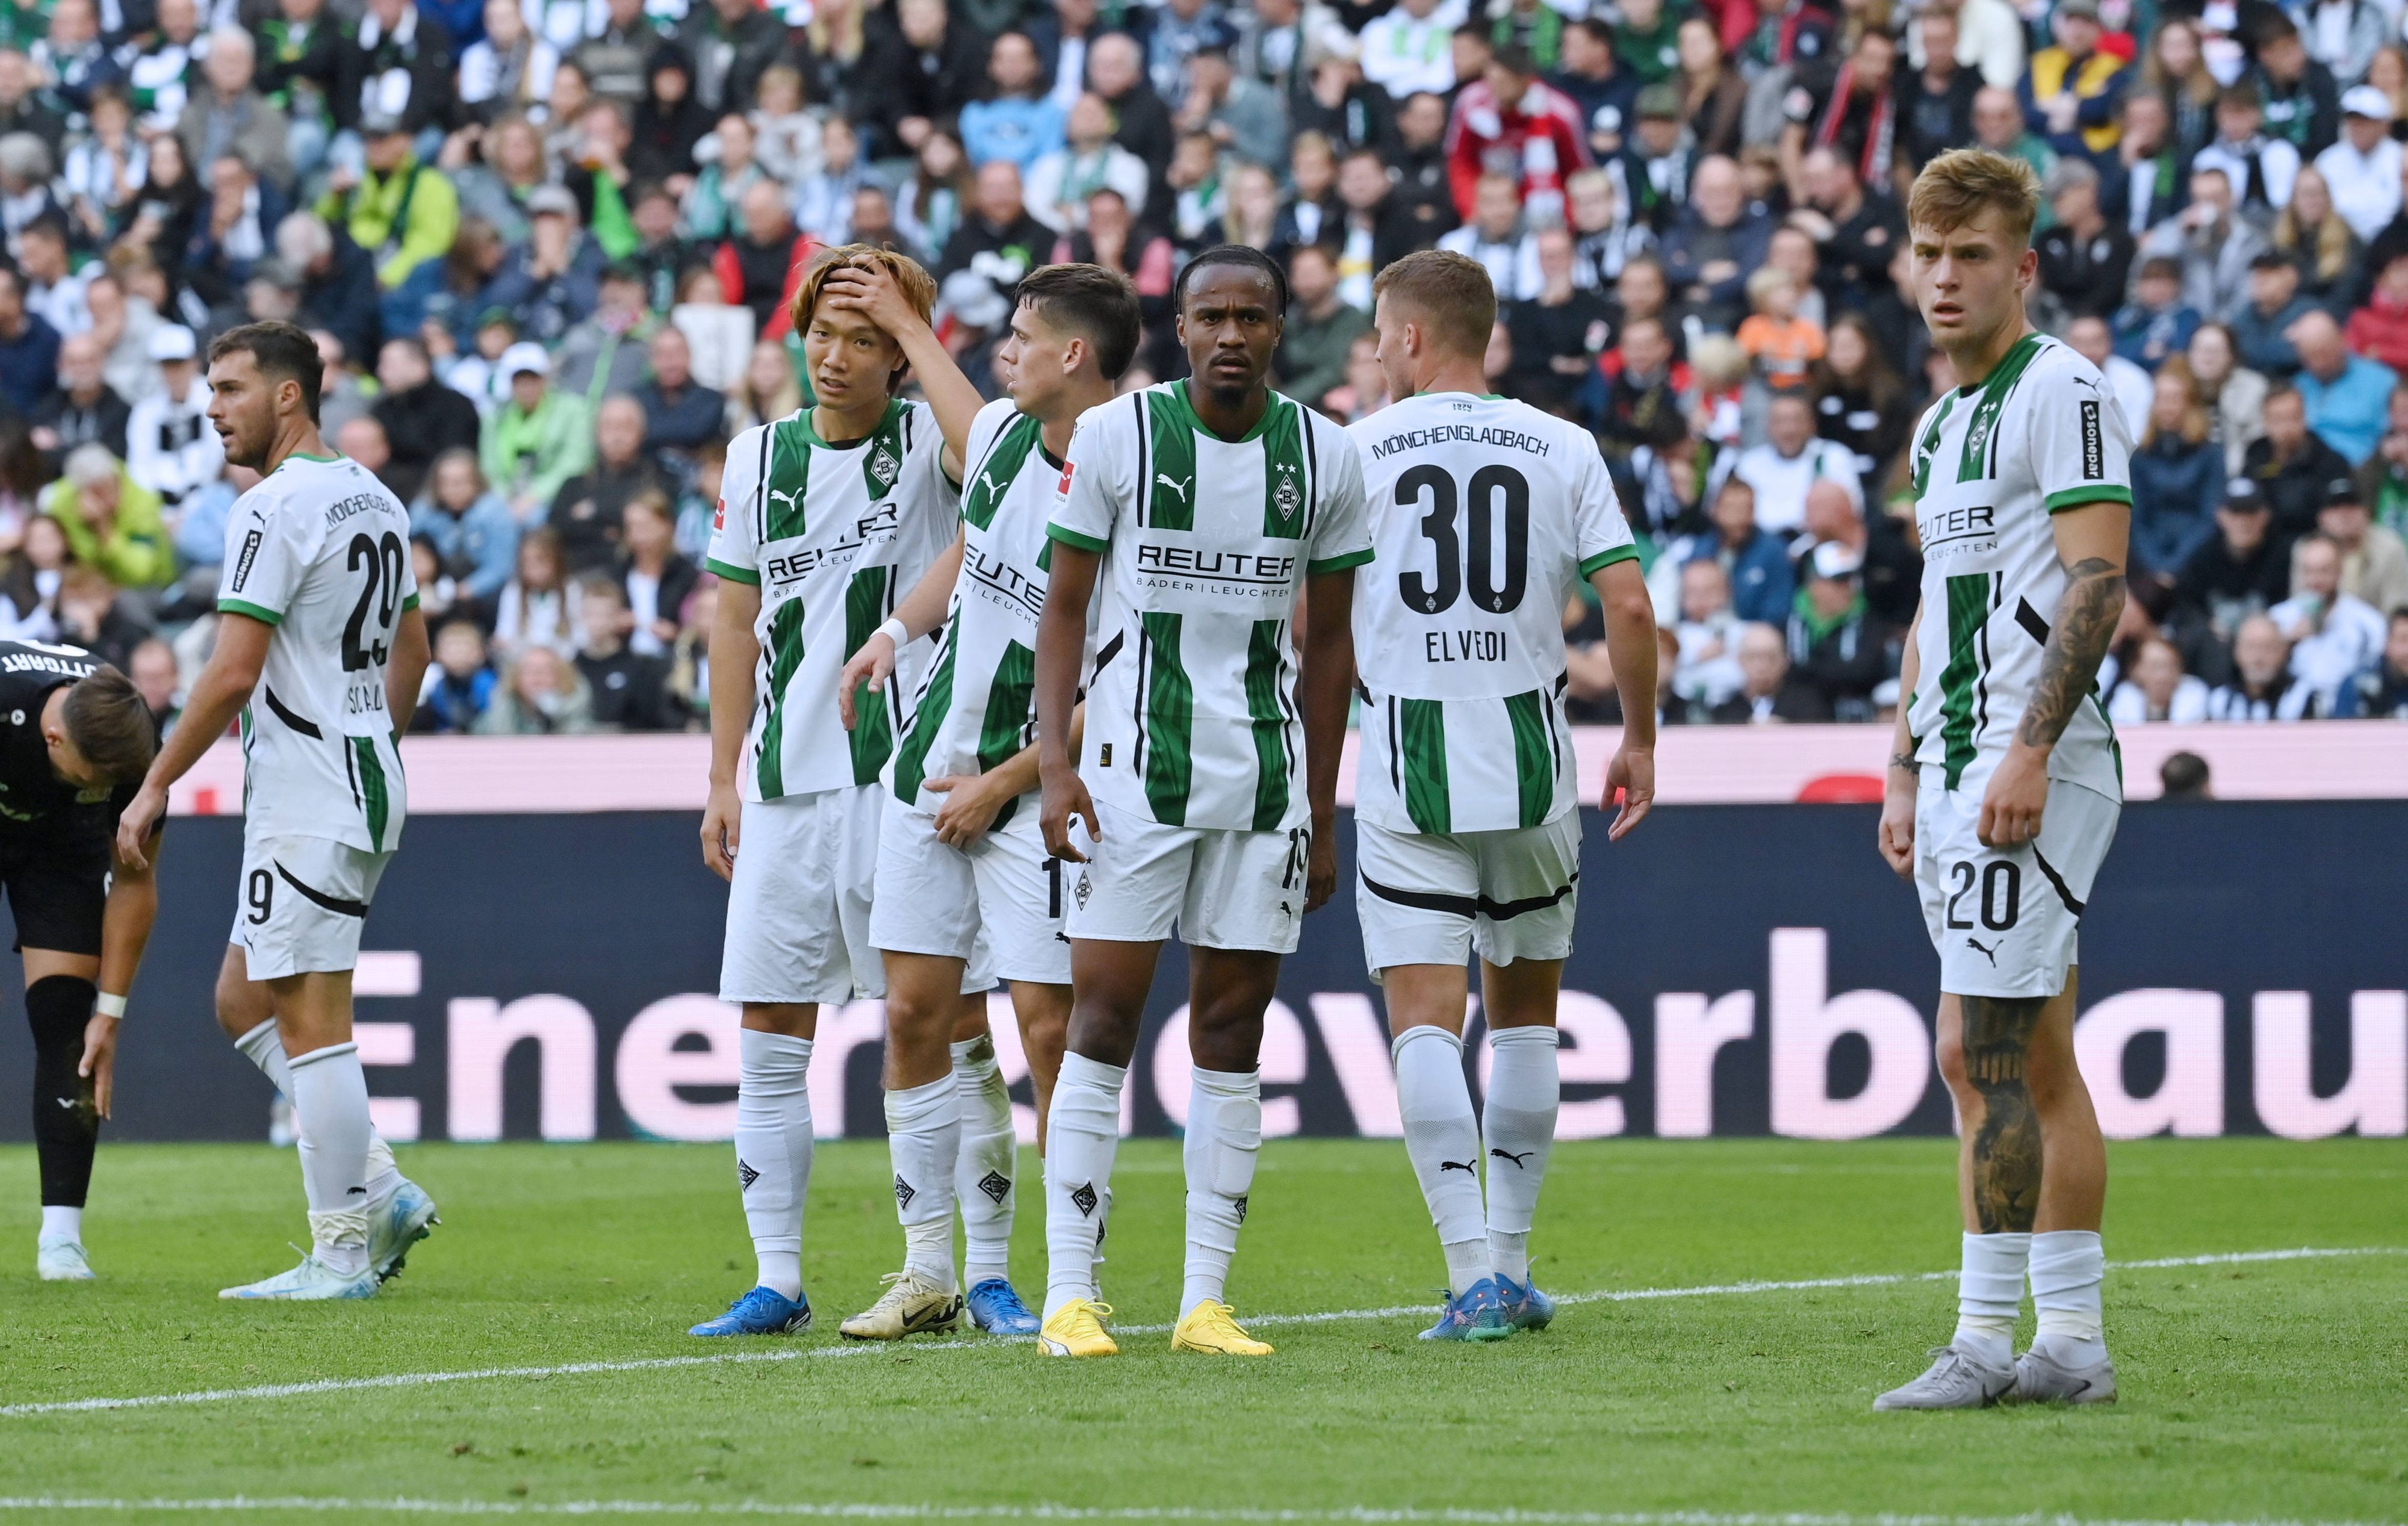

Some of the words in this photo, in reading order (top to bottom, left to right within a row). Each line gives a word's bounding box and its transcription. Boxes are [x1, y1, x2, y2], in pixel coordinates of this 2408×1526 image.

[1371, 424, 1550, 460] MÖNCHENGLADBACH
[2086, 421, 2099, 477] sonepar
[1394, 464, 1530, 615] 30
[1918, 506, 1994, 545] EUTER
[820, 533, 898, 568] LEUTEN
[1138, 545, 1296, 577] REUTER
[1926, 541, 1997, 562] EUCHTEN
[964, 542, 1046, 609] EUTE
[1136, 577, 1194, 592] BÄDER
[1211, 585, 1289, 598] LEUCHTEN
[981, 589, 1040, 628] LEUCHT
[1426, 630, 1506, 663] ELVEDI
[247, 869, 273, 925] 9
[1947, 860, 2021, 931] 20
